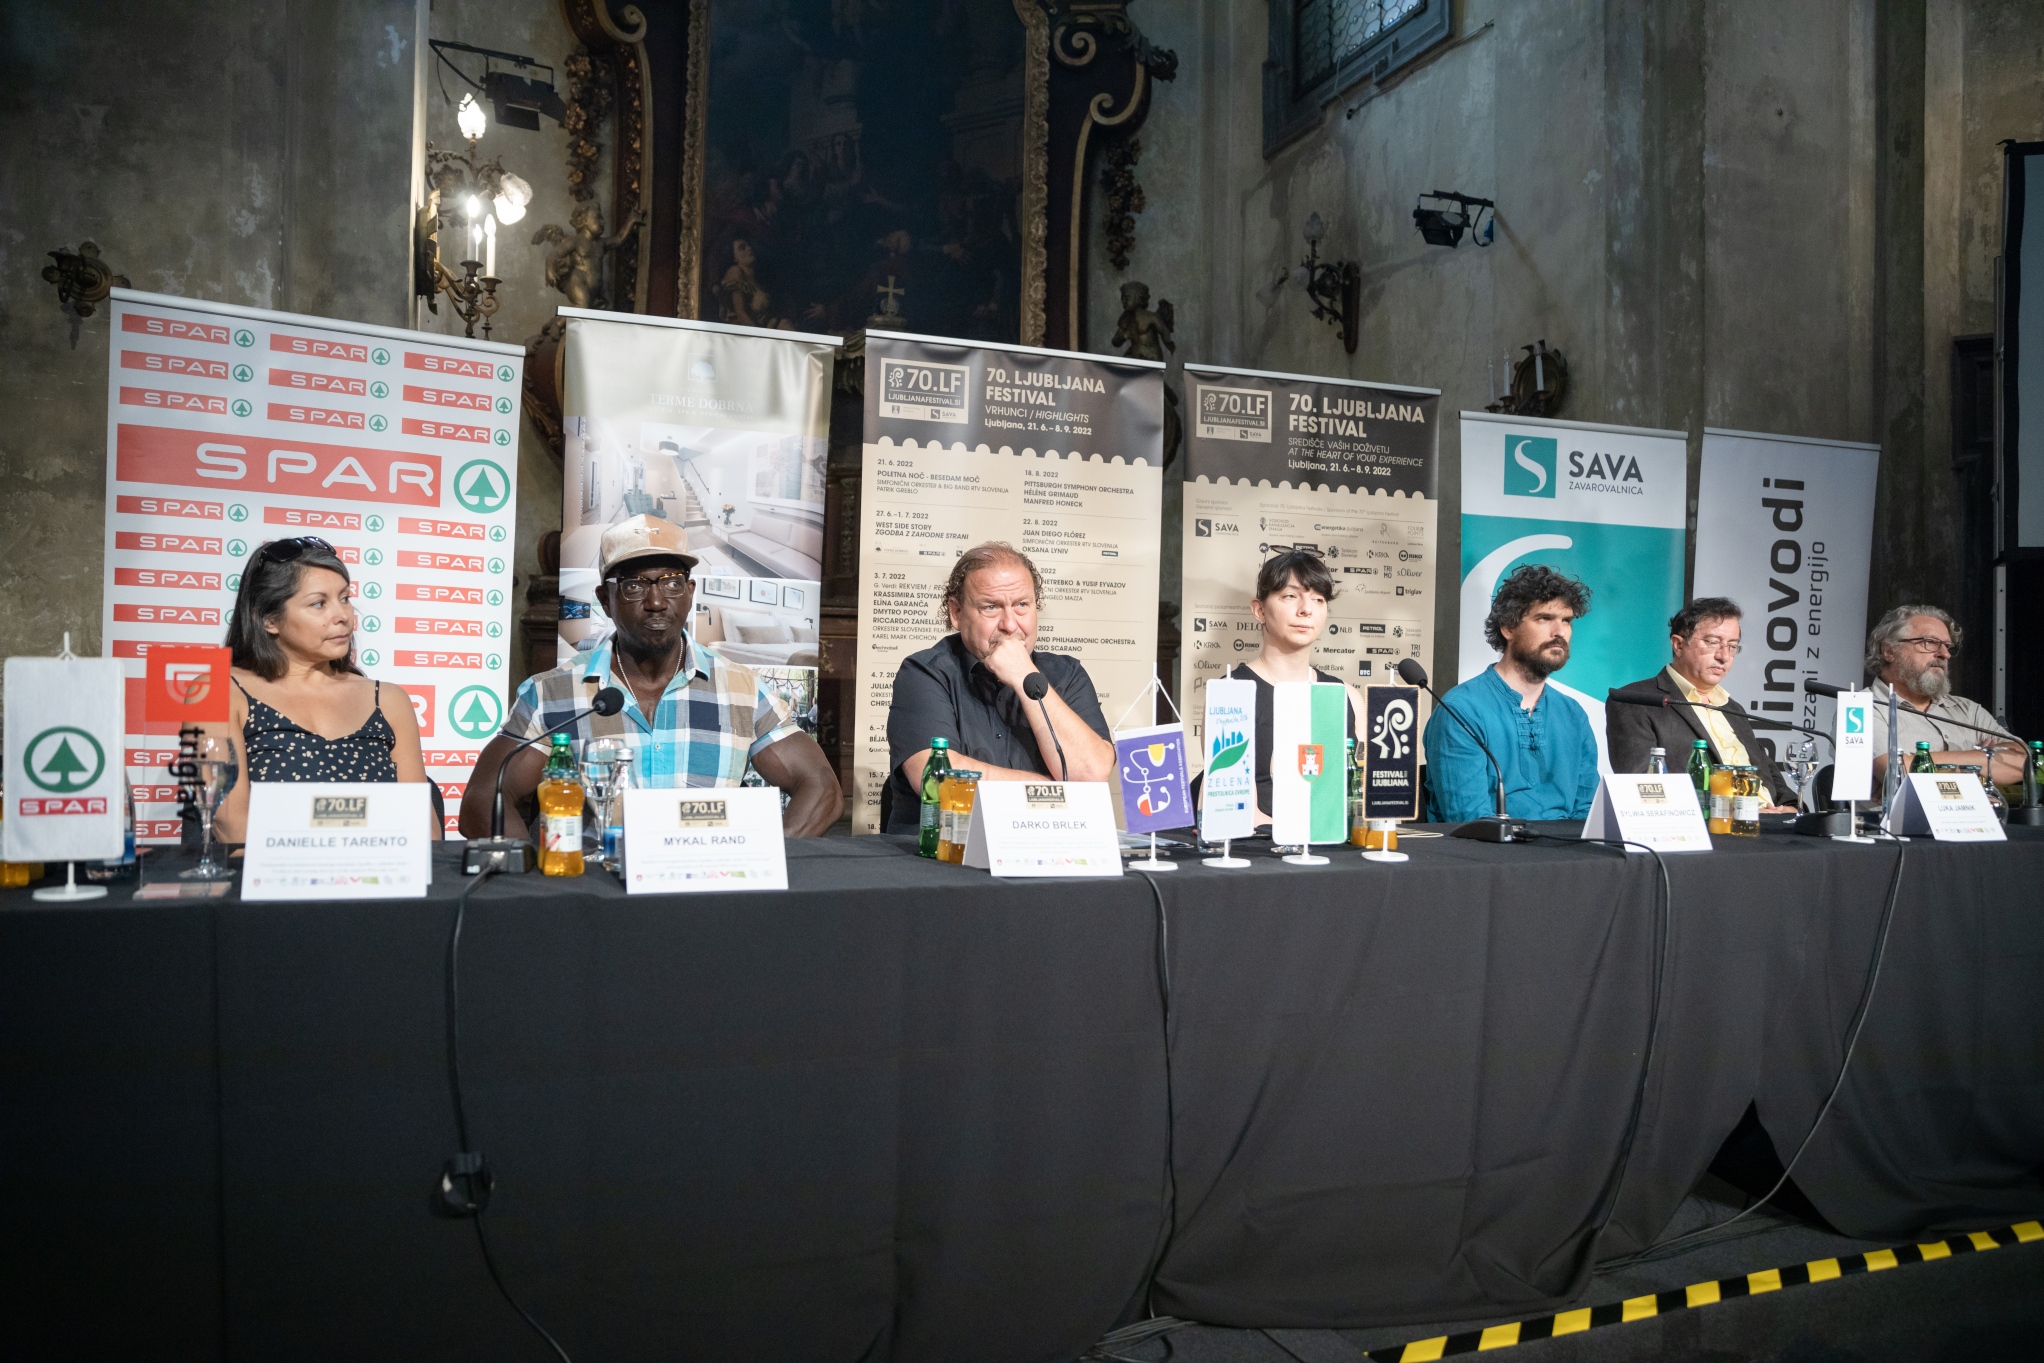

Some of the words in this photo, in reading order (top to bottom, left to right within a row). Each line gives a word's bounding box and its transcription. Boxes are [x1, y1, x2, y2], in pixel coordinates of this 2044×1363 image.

[147, 320, 228, 342] SPAR
[292, 339, 365, 360] SPAR
[146, 356, 226, 378] SPAR
[424, 358, 493, 377] SPAR
[291, 374, 364, 393] SPAR
[907, 369, 961, 392] 70.LF
[987, 368, 1010, 384] 70.
[1015, 372, 1105, 393] LJUBLJANA
[144, 392, 225, 412] SPAR
[423, 390, 492, 409] SPAR
[650, 393, 694, 408] TERME
[699, 399, 753, 412] DOBRNA
[888, 393, 960, 405] LJUBLJANAFESTIVAL.SI
[986, 386, 1055, 406] FESTIVAL
[1219, 394, 1265, 415] 70.LF
[985, 405, 1027, 418] VRHUNCI
[1035, 410, 1089, 423] HIGHLIGHTS
[1289, 394, 1317, 413] 70.
[1323, 397, 1425, 423] LJUBLJANA
[290, 408, 363, 427] SPAR
[1204, 416, 1265, 426] LJUBLJANAFESTIVAL.SI
[422, 423, 490, 441] SPAR
[985, 419, 1025, 430] Ljubljana,
[1028, 422, 1040, 431] 21.
[1073, 426, 1092, 435] 2022
[1289, 415, 1367, 438] FESTIVAL
[1288, 436, 1324, 449] SREDIŠČE
[1328, 440, 1350, 450] VAŠIH
[1301, 448, 1314, 457] THE
[1317, 450, 1340, 460] HEART
[1343, 452, 1354, 460] OF
[1357, 453, 1376, 463] YOUR
[1379, 454, 1423, 467] EXPERIENCE
[1568, 450, 1644, 482] SAVA
[196, 442, 434, 497] SPAR
[1288, 460, 1328, 471] Ljubljana,
[1330, 463, 1342, 472] 21.
[1373, 466, 1391, 476] 2022
[1064, 483, 1097, 492] SYMPHONY
[1099, 486, 1134, 494] ORCHESTRA
[1569, 481, 1643, 495] ZAVAROVALNICA
[140, 500, 222, 518] SPAR
[286, 512, 360, 528] SPAR
[1215, 523, 1239, 532] SAVA
[418, 521, 484, 538] SPAR
[1064, 530, 1086, 539] FLÓREZ
[139, 536, 220, 553] SPAR
[418, 555, 482, 570] SPAR
[138, 572, 219, 587] SPAR
[416, 588, 481, 602] SPAR
[1808, 541, 1829, 636] energijo
[137, 609, 218, 622] SPAR
[415, 621, 480, 634] SPAR
[1236, 622, 1263, 631] DELO
[414, 654, 480, 666] SPAR
[1845, 736, 1864, 744] SAVA
[1208, 777, 1250, 787] ZELENA
[21, 800, 106, 813] SPAR
[1012, 821, 1049, 829] DARKO
[1053, 821, 1087, 829] BRLEK
[266, 837, 336, 848] DANIELLE
[342, 836, 407, 847] TARENTO
[664, 836, 707, 846] MYKAL
[712, 836, 746, 845] RAND
